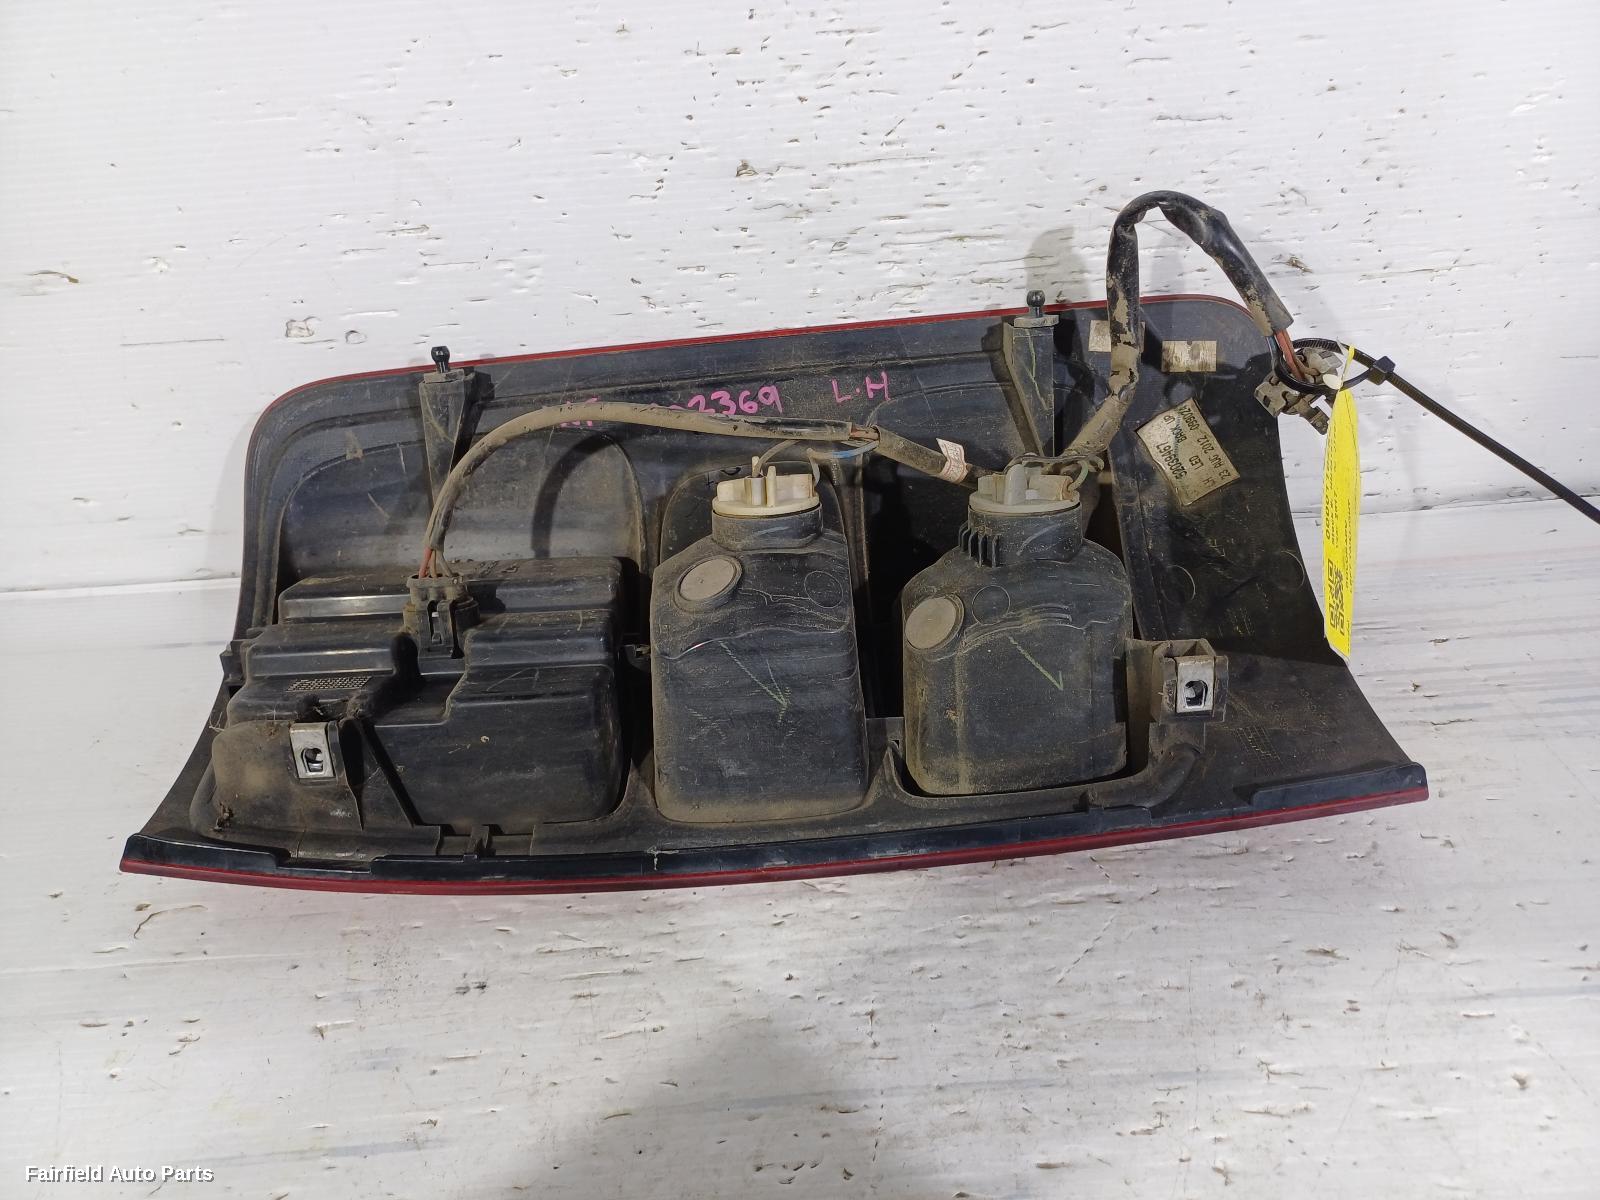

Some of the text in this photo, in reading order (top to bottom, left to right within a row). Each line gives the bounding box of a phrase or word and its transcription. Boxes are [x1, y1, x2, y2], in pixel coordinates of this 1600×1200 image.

[1163, 414, 1176, 425] UP
[1171, 424, 1187, 443] BACK
[1197, 434, 1214, 454] 2012
[1156, 441, 1187, 479] 52039467
[1189, 455, 1204, 470] LED
[1208, 454, 1222, 469] AUG
[1218, 469, 1231, 480] 23
